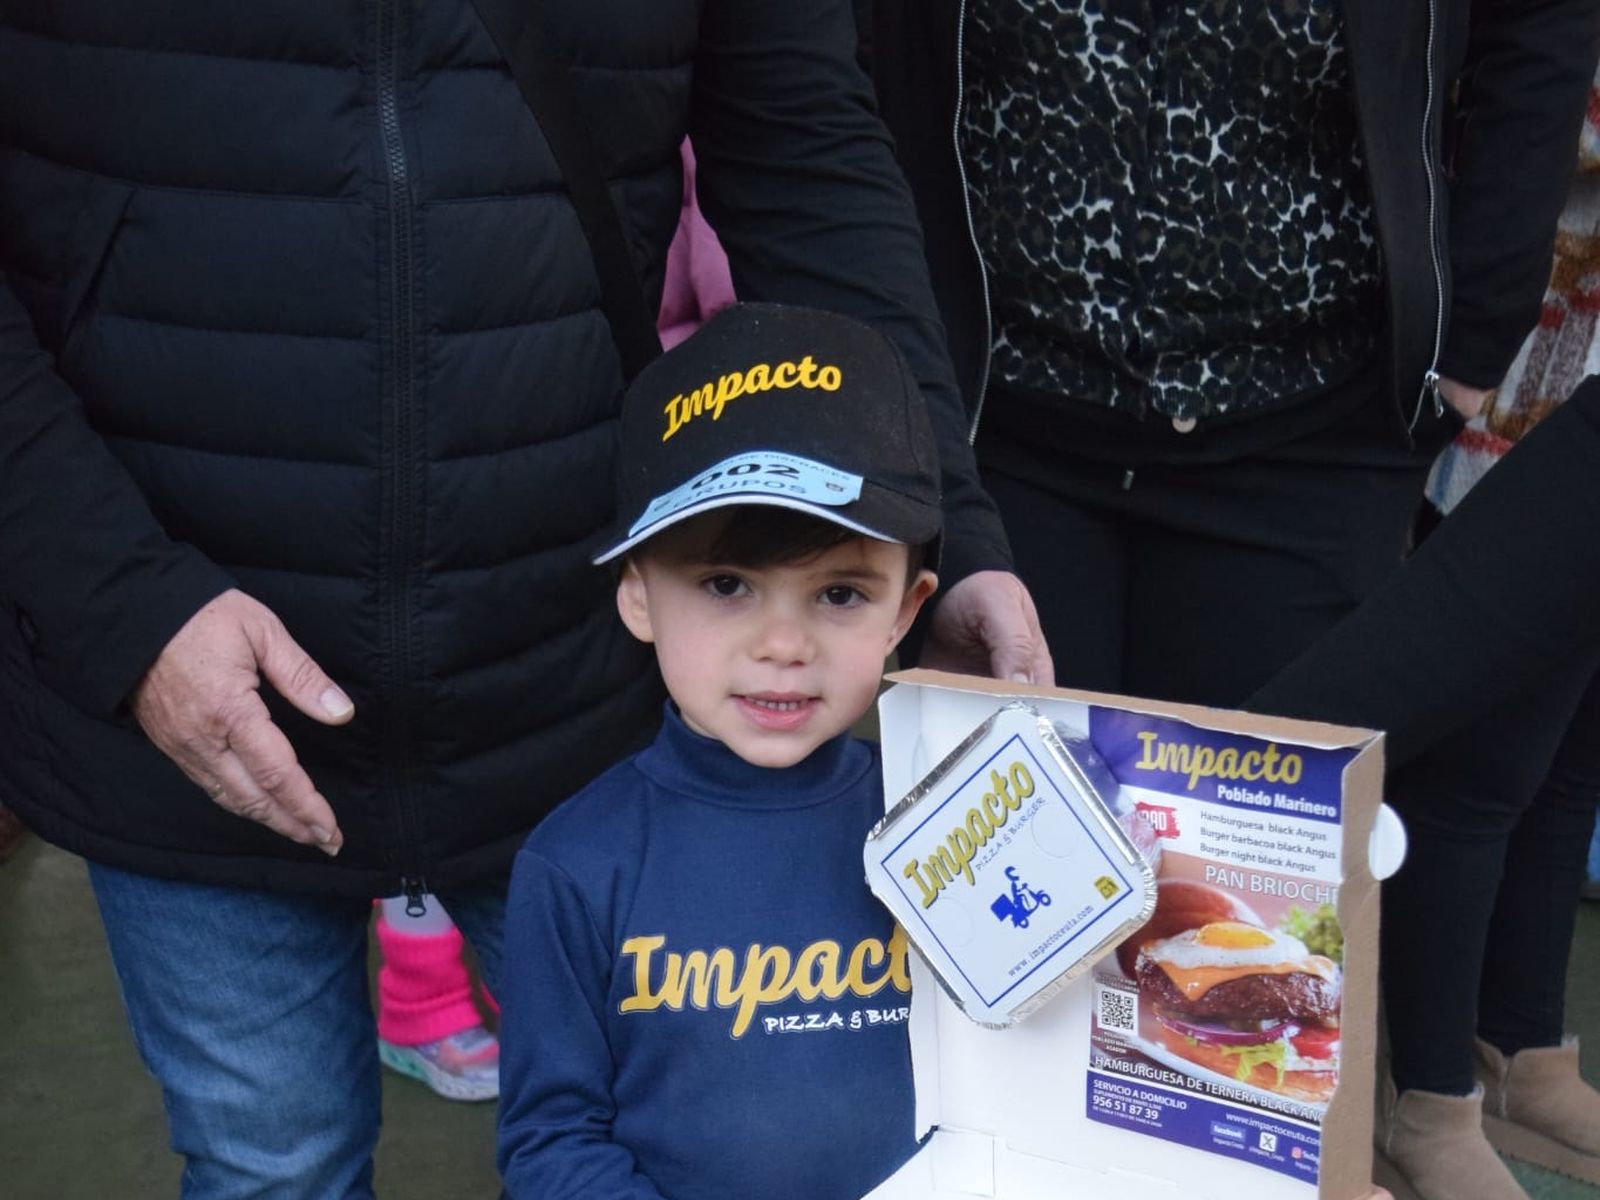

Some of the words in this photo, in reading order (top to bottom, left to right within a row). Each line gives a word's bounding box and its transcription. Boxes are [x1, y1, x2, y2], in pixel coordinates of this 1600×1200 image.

[662, 356, 842, 442] Impacto
[1135, 731, 1303, 791] Impacto
[1217, 784, 1271, 807] Poblado
[1273, 793, 1337, 817] Marinero
[903, 761, 1036, 910] Impacto
[1200, 810, 1264, 831] Hamburguesa
[1268, 823, 1294, 836] black
[1296, 828, 1327, 842] Angus
[1200, 827, 1230, 841] Burger
[1231, 834, 1276, 849] barbacoa
[1277, 842, 1304, 854] black
[1305, 846, 1337, 860] Angus
[1200, 843, 1230, 857] Burger
[1231, 849, 1256, 863] night
[1258, 855, 1283, 867] black
[1285, 860, 1316, 873] Angus
[1205, 865, 1244, 889] PAN
[764, 1011, 844, 1033] PIZZA
[1093, 1079, 1132, 1096] SERVICIO
[1132, 1089, 1139, 1098] A
[1140, 1091, 1187, 1110] DOMICILIO
[1095, 1056, 1184, 1087] HAMBURGUESA
[1187, 1077, 1203, 1091] DE
[1206, 1082, 1258, 1105] TERNERA
[1260, 1097, 1298, 1115] BLACK
[1093, 1095, 1112, 1109] 956
[1114, 1100, 1126, 1112] 51
[1129, 1105, 1143, 1116] 87
[1144, 1108, 1159, 1120] 39
